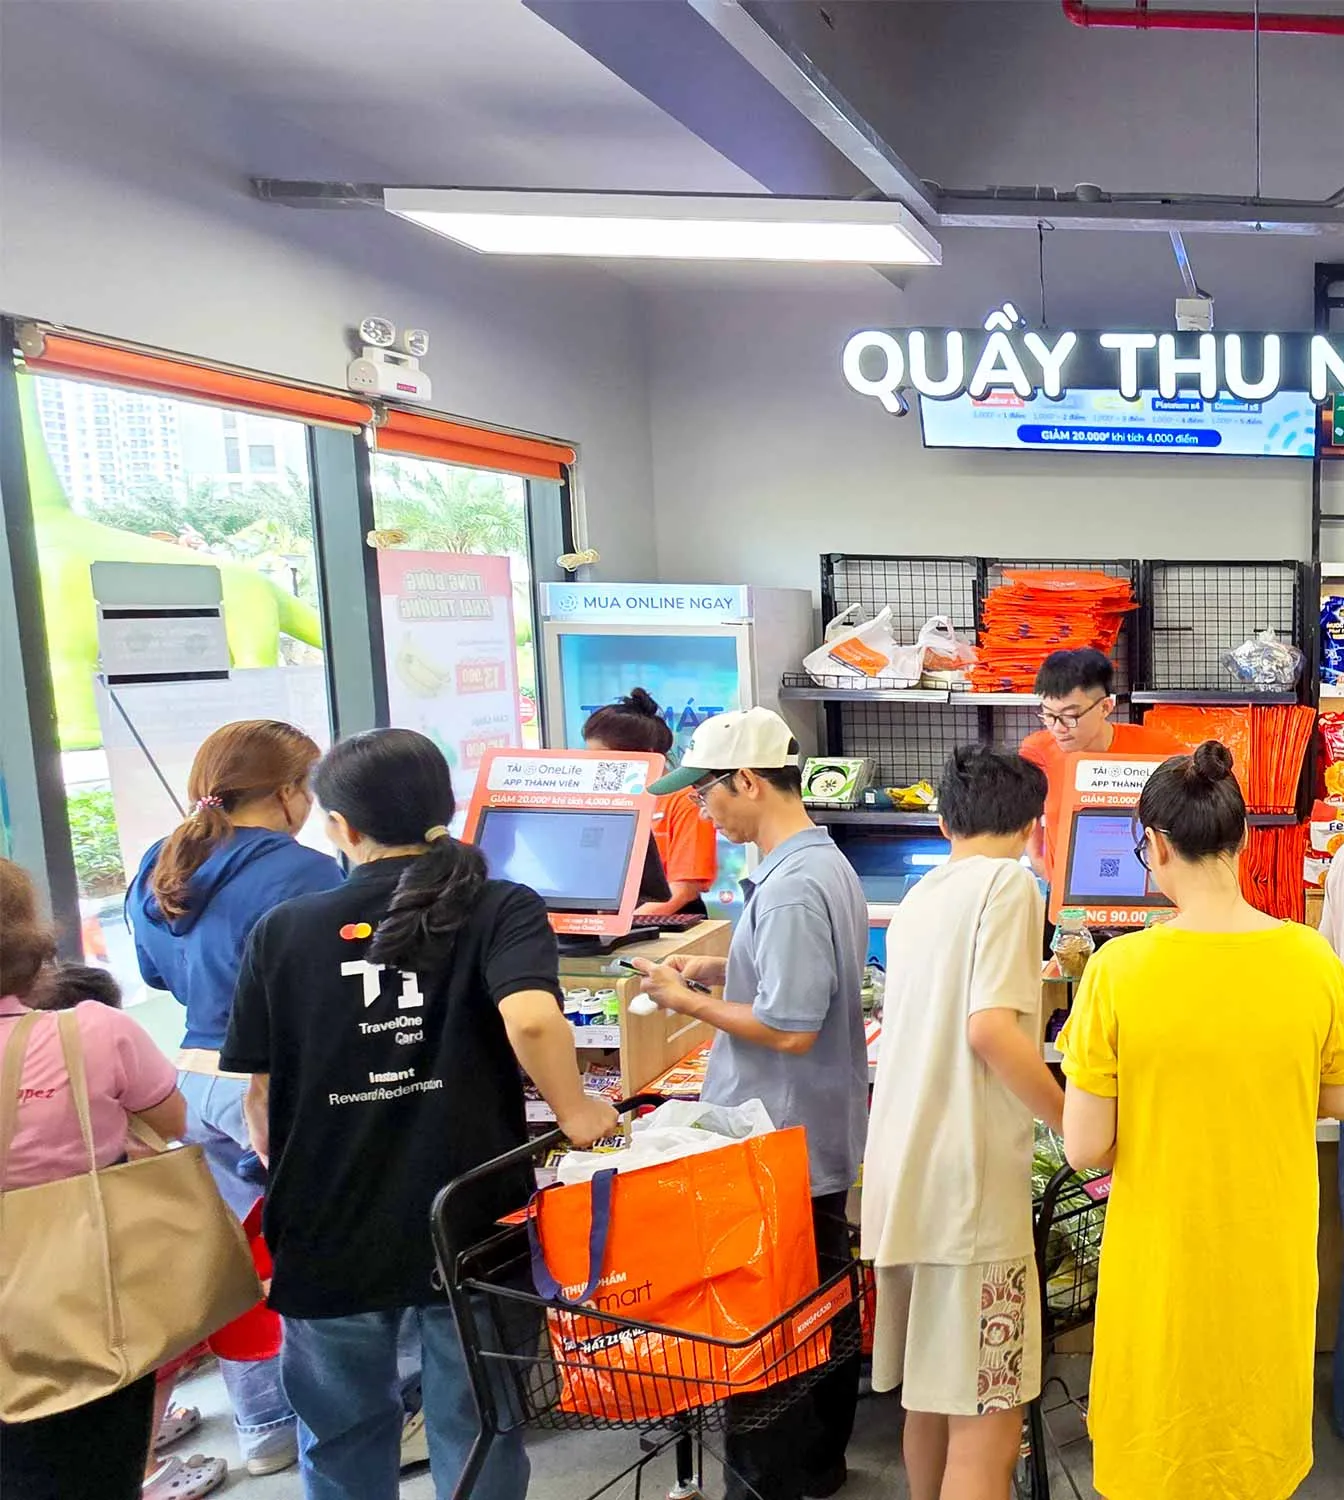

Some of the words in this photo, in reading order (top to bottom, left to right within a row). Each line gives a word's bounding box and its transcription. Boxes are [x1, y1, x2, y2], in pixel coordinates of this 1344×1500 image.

[842, 303, 1077, 415] QUẦY
[1100, 333, 1281, 400] THU
[1041, 428, 1070, 441] GIẢM
[1111, 432, 1126, 442] khi
[1127, 432, 1145, 442] tích
[1175, 433, 1199, 444] điểm
[583, 596, 621, 610] MUA
[625, 596, 685, 610] ONLINE
[689, 596, 733, 611] NGAY
[507, 764, 522, 773] TẢI
[538, 764, 583, 776] OneLife
[1093, 766, 1107, 775] TẢI
[1123, 767, 1153, 777] OneL
[503, 778, 522, 786] APP
[524, 777, 556, 788] THÀNH
[558, 778, 580, 788] VIÊN
[1111, 779, 1143, 788] THÀNH
[1081, 794, 1105, 804] GIẢM
[1109, 910, 1146, 923] 90.00
[359, 1015, 423, 1035] TravelOne
[395, 1031, 424, 1046] Card
[369, 1067, 415, 1084] Instant
